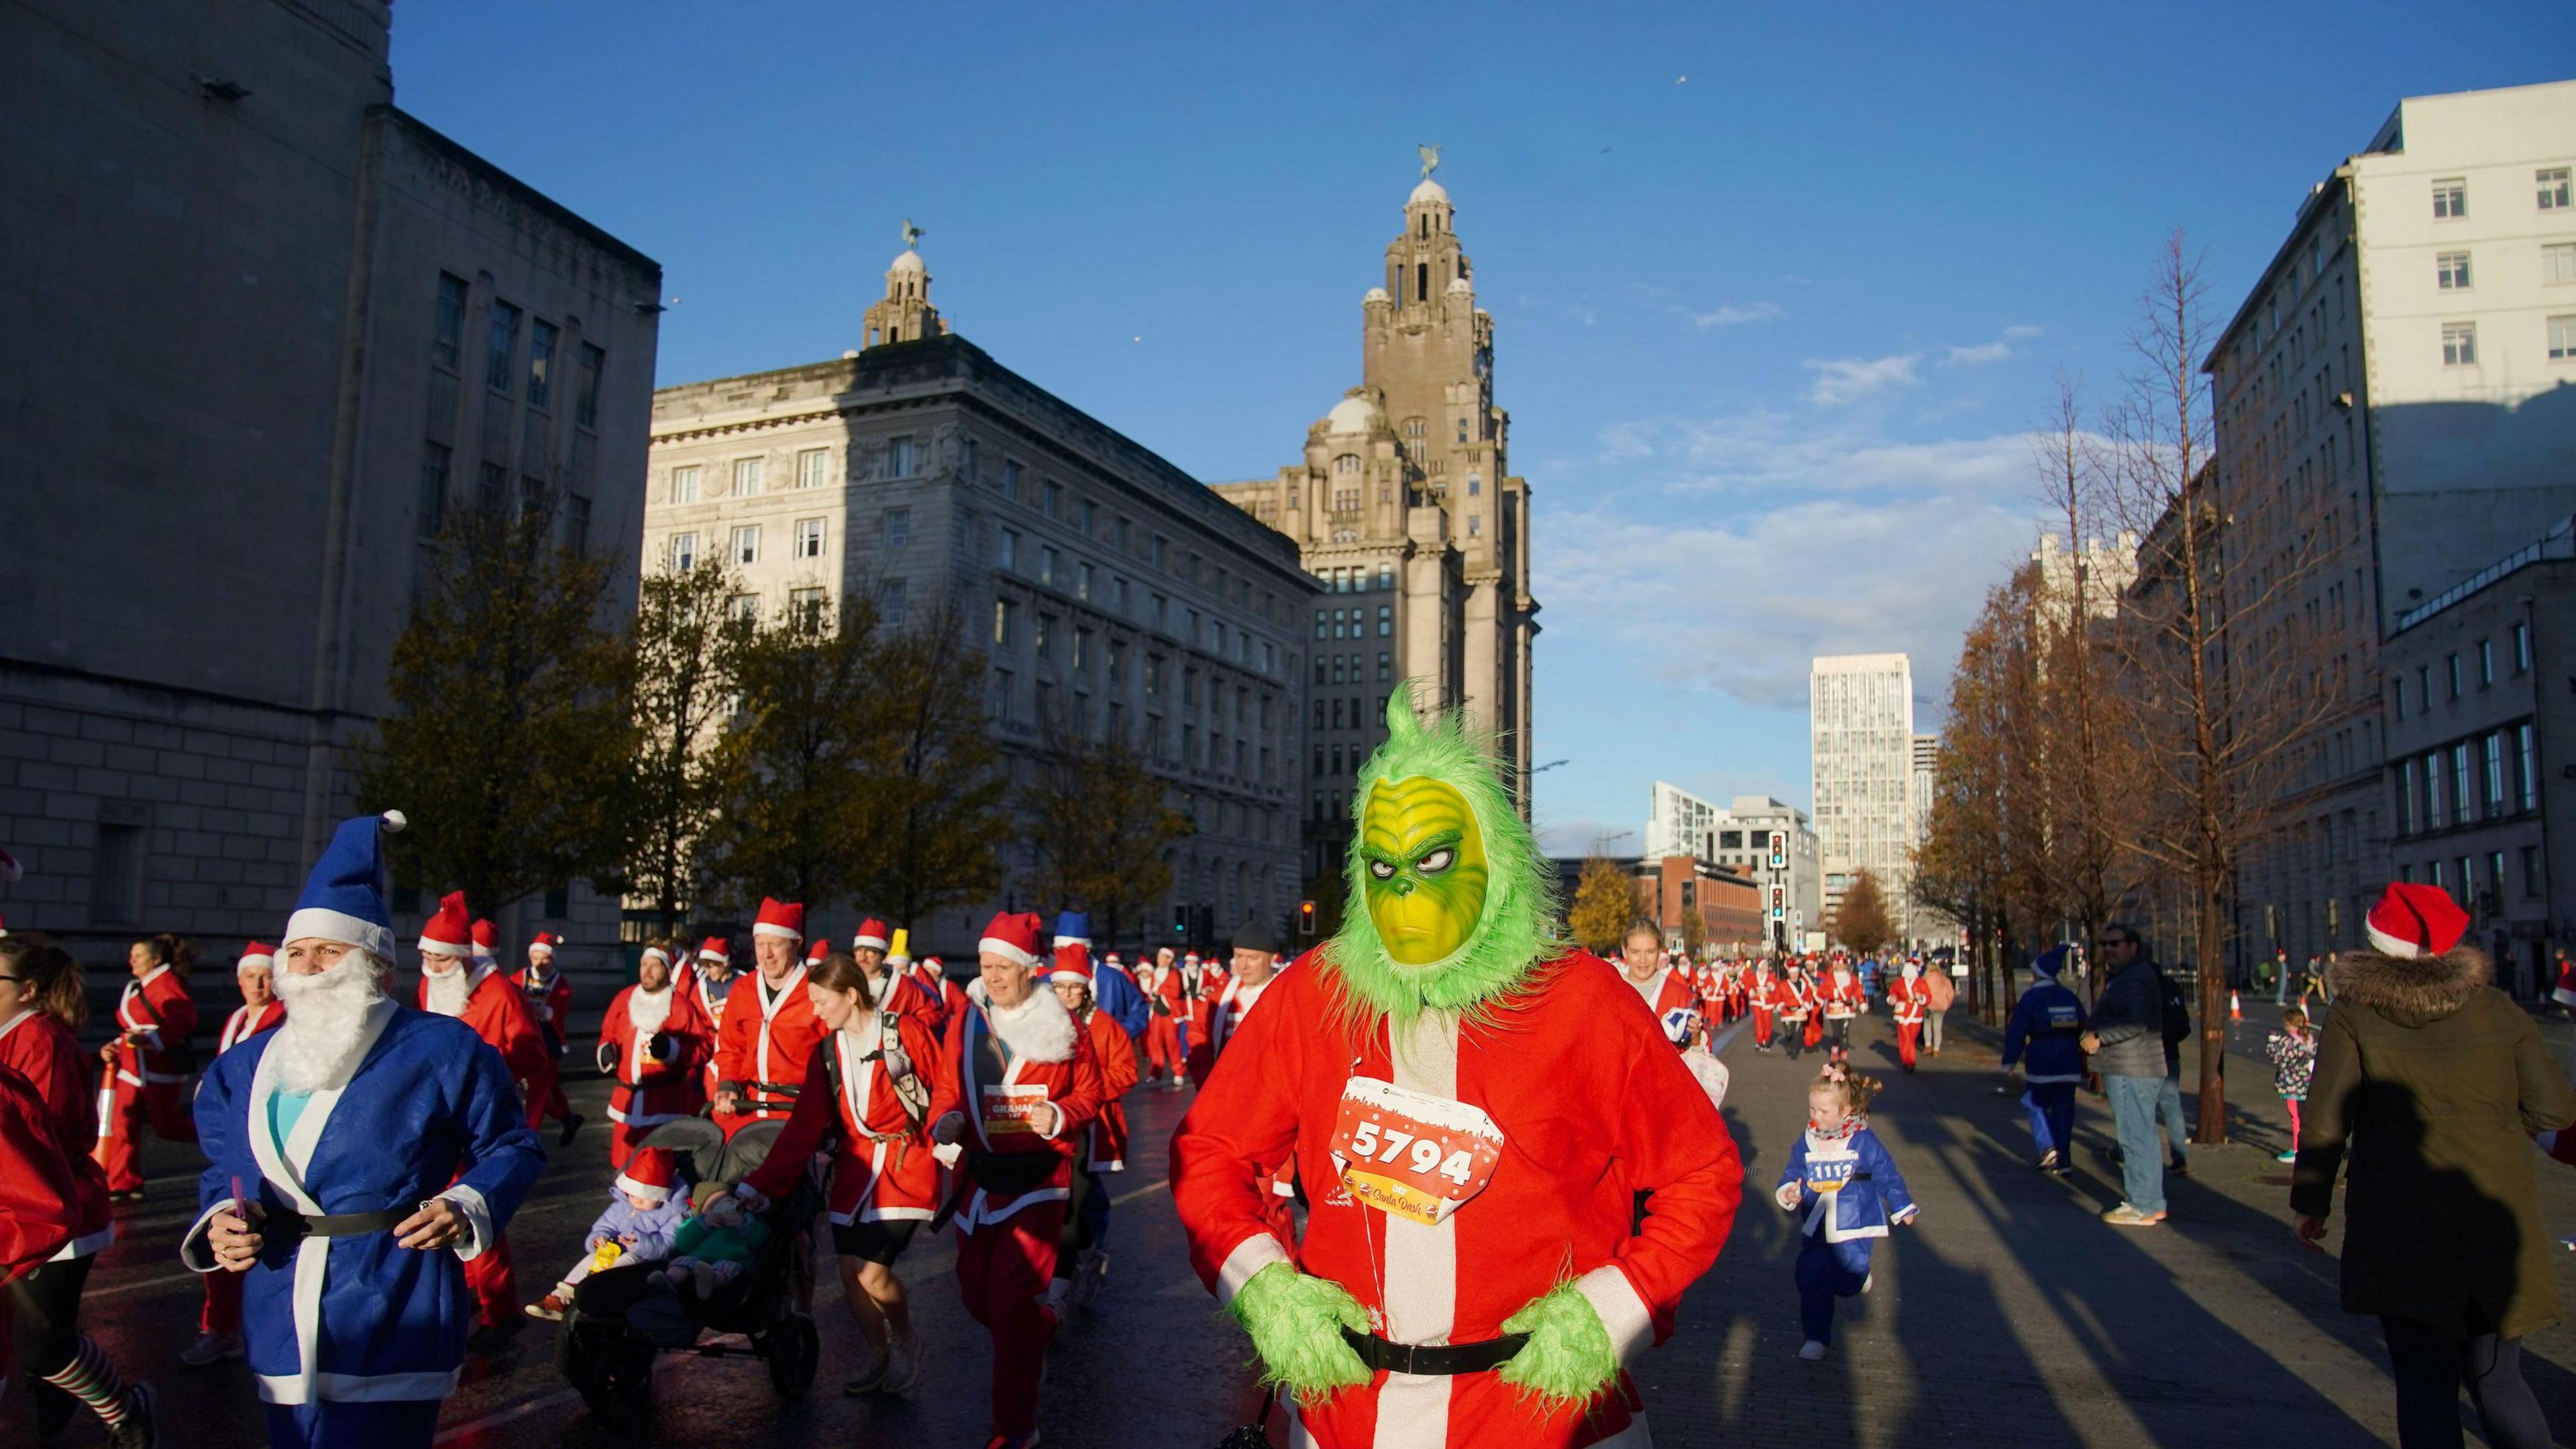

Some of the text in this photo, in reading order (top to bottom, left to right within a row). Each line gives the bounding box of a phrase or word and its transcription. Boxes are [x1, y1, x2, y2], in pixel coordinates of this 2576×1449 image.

[1350, 1120, 1473, 1187] 5794
[1815, 1165, 1852, 1178] 1112
[1373, 1188, 1397, 1207] Santa
[1398, 1197, 1422, 1216] Dash
